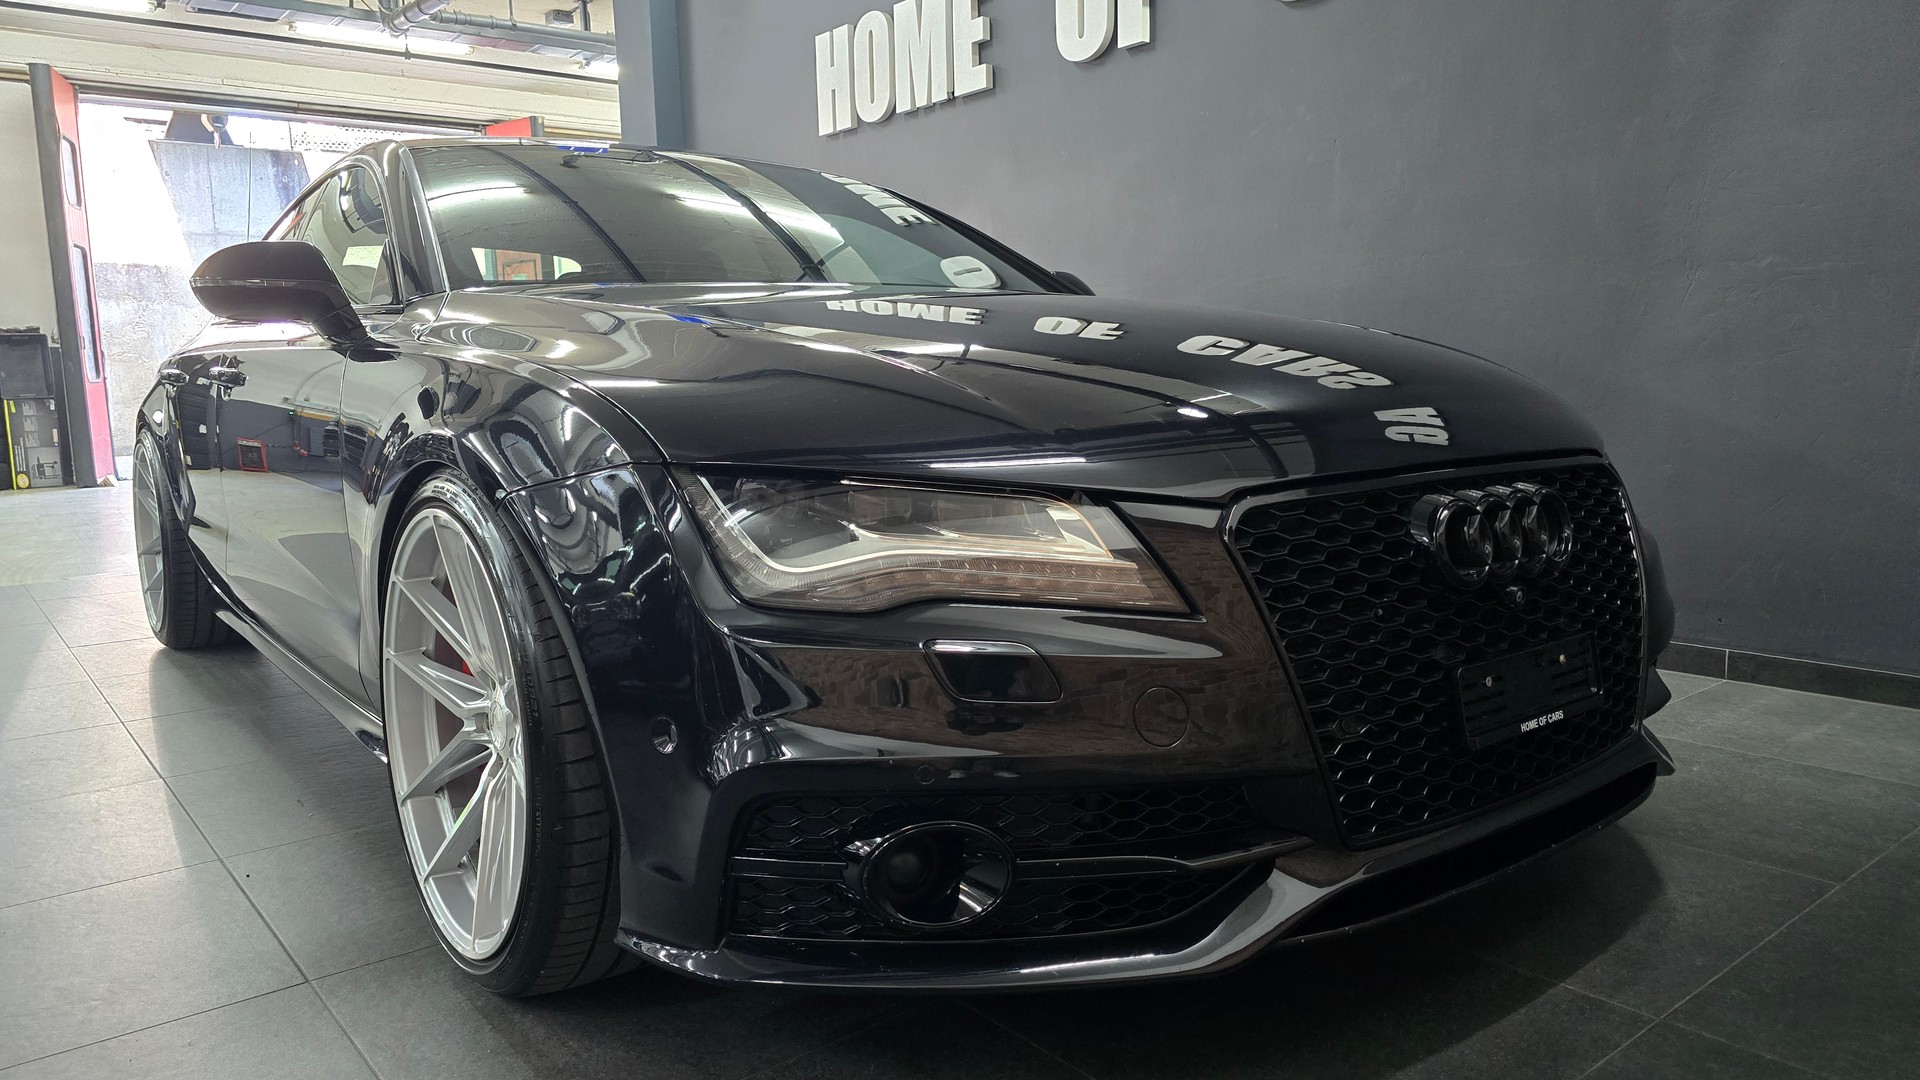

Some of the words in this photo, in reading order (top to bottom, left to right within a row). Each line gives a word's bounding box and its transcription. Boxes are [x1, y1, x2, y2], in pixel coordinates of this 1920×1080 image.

[815, 0, 994, 136] HOME
[1520, 718, 1538, 732] HOME
[1538, 715, 1547, 726] OF
[1547, 710, 1564, 723] CARS
